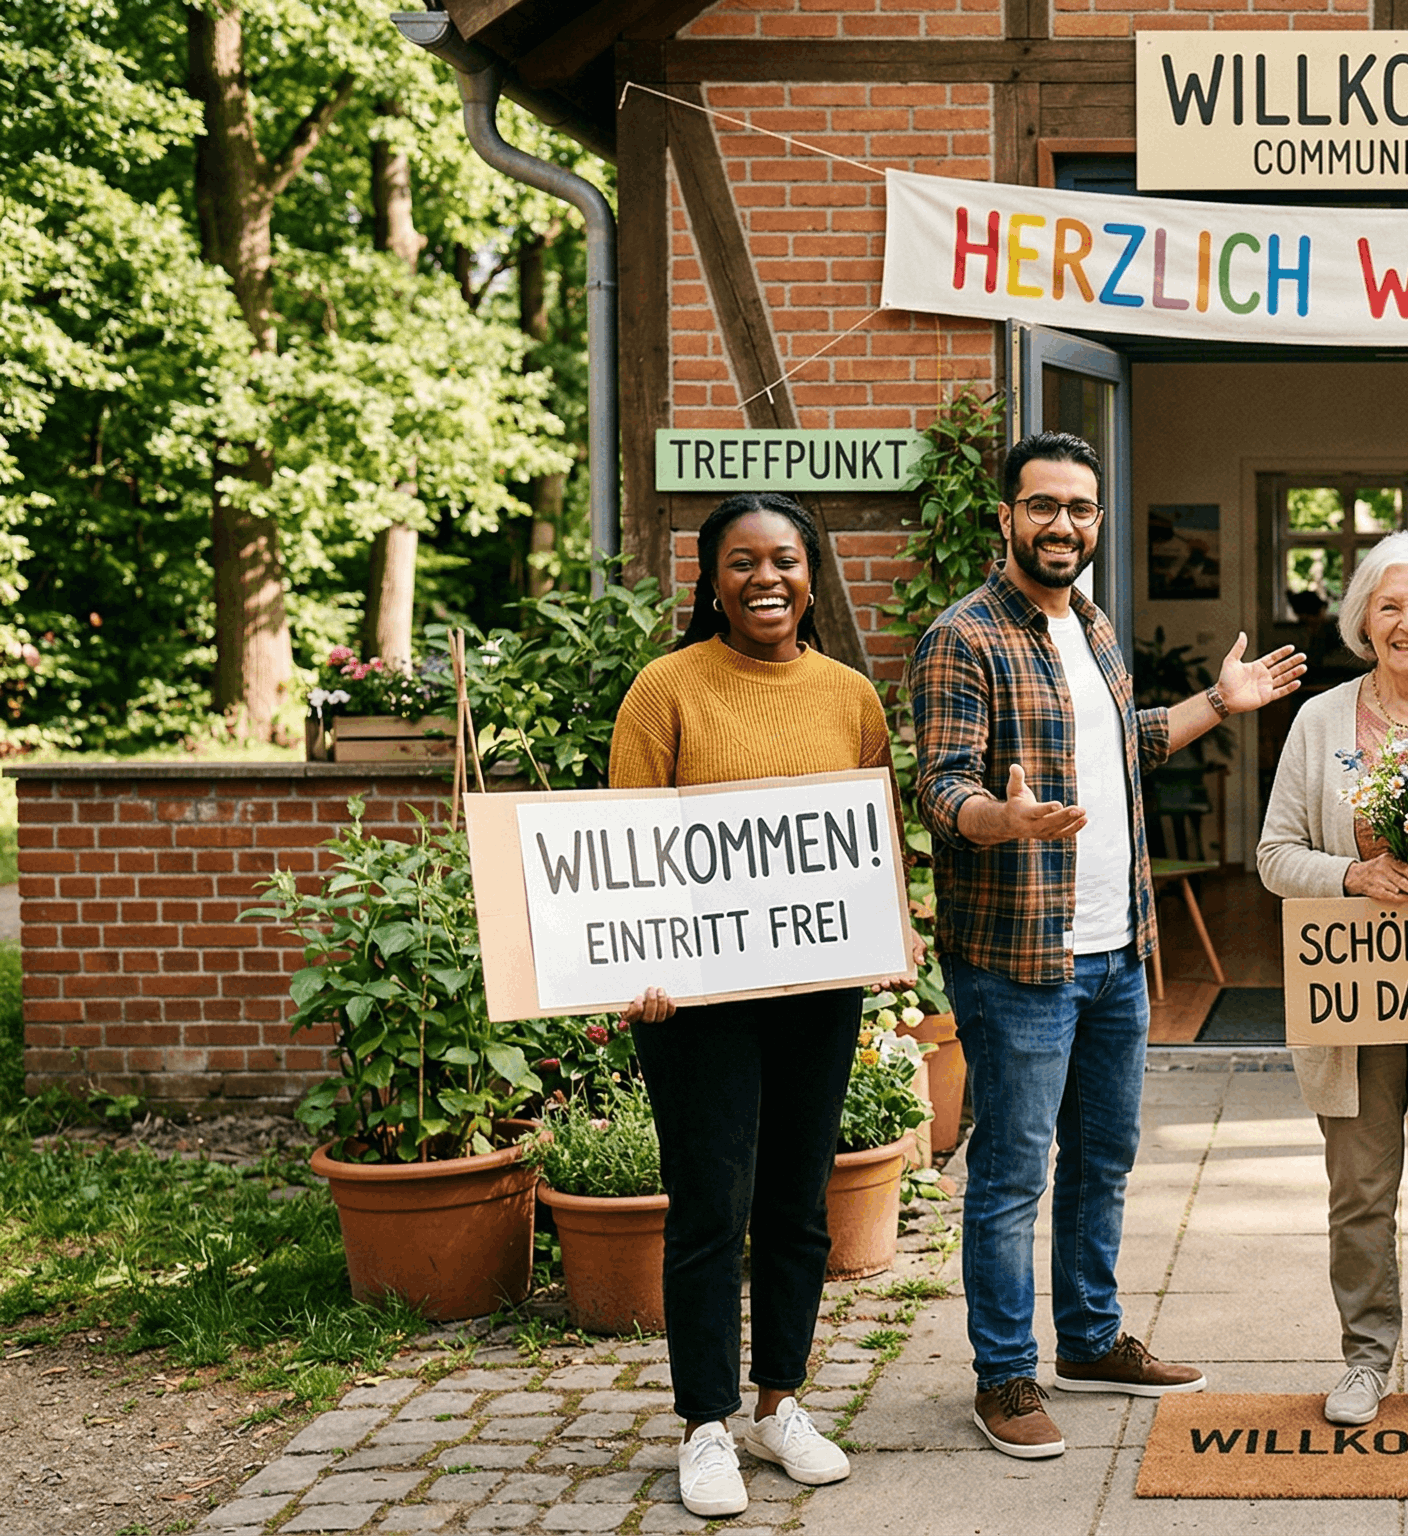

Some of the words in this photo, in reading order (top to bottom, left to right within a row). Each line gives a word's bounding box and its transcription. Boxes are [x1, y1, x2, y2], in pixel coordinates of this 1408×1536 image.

[952, 206, 1311, 317] HERZLICH
[669, 439, 908, 480] TREFFPUNKT
[535, 802, 883, 894] WILLKOMMEN!
[586, 909, 750, 965] EINTRITT
[768, 900, 849, 949] FREI
[1309, 981, 1359, 1025] DU
